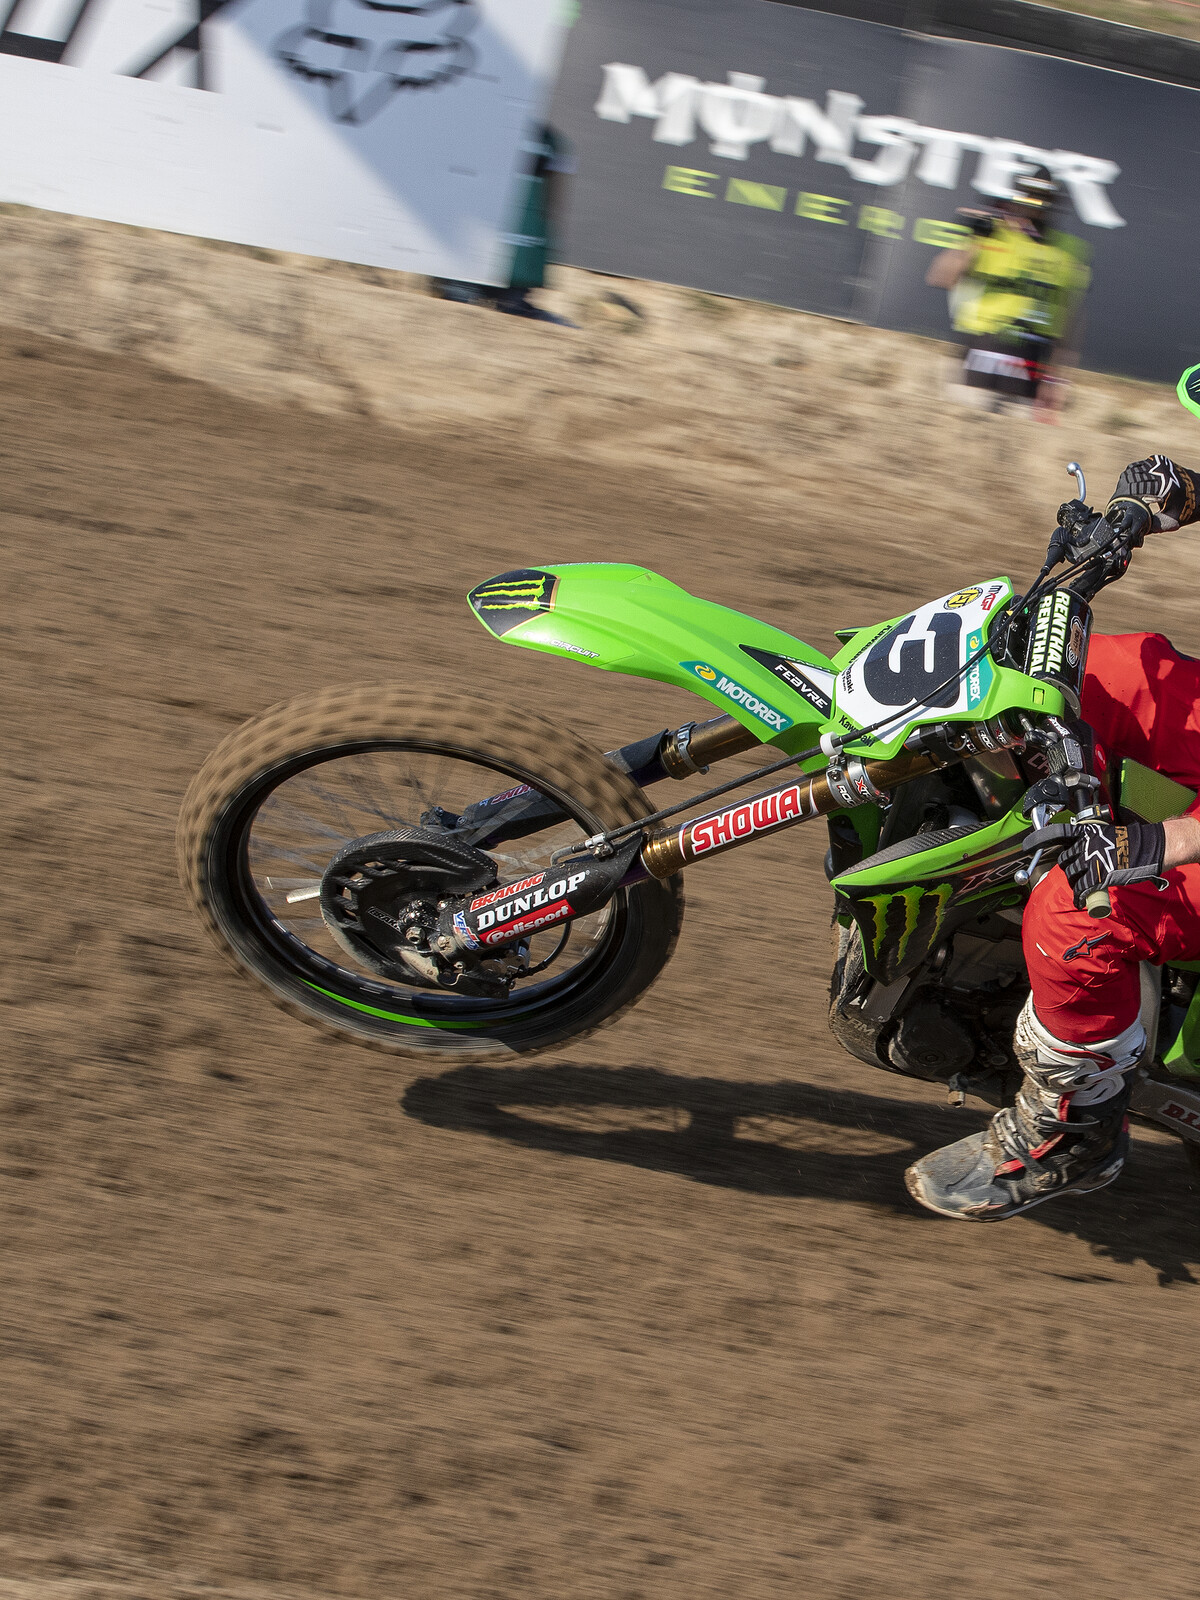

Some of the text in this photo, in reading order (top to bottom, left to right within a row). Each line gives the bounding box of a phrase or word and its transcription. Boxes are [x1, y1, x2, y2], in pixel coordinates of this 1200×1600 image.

[595, 62, 1126, 228] MONSTER
[661, 165, 976, 249] ENERG
[1029, 595, 1053, 676] RENTHAL
[1045, 591, 1071, 673] RENTHAL
[716, 676, 787, 731] MOTOREX
[969, 650, 982, 702] MTOREX
[838, 715, 876, 747] Kawaki
[692, 785, 803, 856] SHOWA
[470, 872, 546, 912] BRAKING
[477, 870, 587, 931] DUNLOP
[485, 905, 570, 945] Polisport
